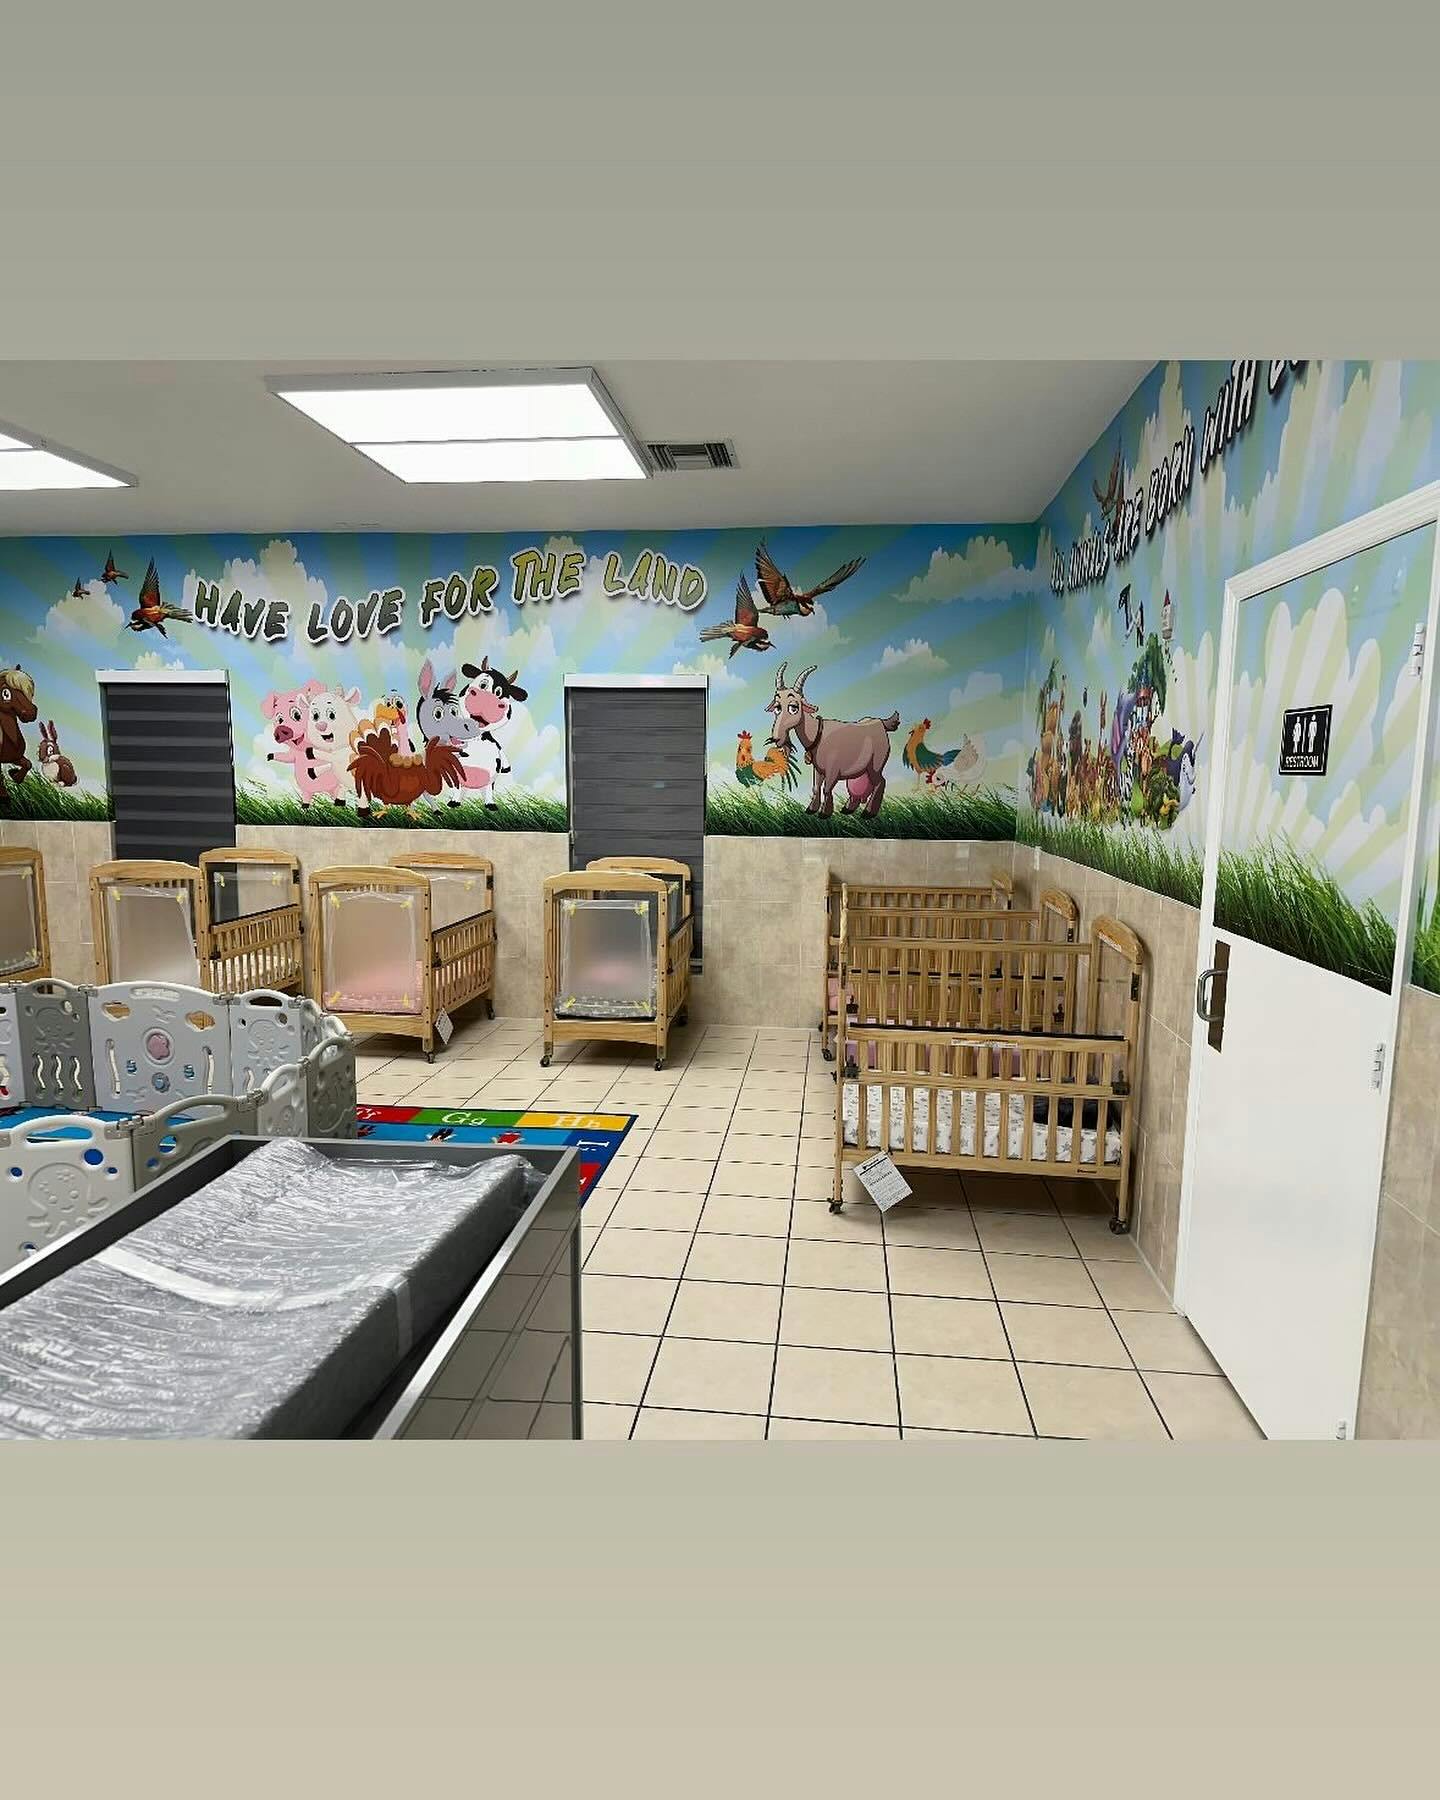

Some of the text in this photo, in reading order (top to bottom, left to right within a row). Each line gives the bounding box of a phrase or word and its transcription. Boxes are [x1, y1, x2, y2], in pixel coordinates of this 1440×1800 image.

[1114, 487, 1144, 563] ARE
[1146, 425, 1195, 536] BORN
[1201, 360, 1257, 474] WITH
[194, 551, 706, 642] HAVE LOVE FOR THE LAND
[1283, 755, 1319, 768] RESTROOM
[441, 1111, 487, 1126] Gg
